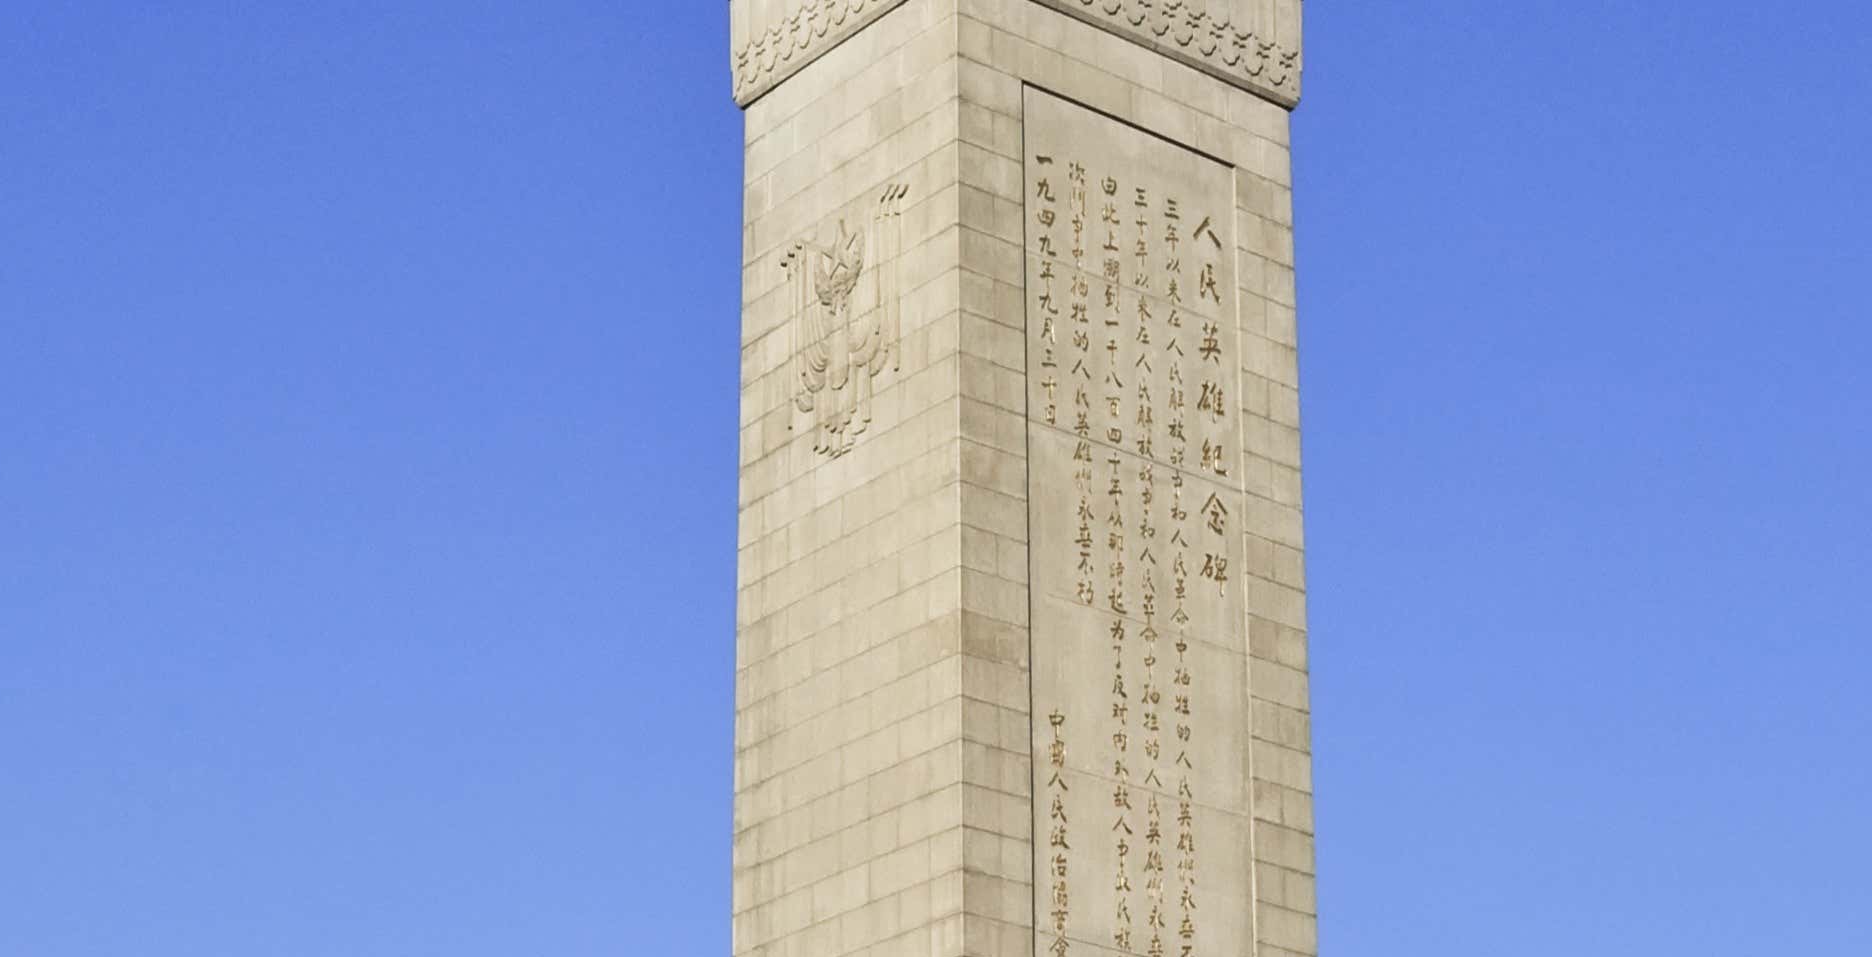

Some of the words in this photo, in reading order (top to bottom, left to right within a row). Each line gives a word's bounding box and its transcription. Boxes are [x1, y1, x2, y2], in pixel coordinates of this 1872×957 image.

[1036, 155, 1059, 426] 一九四九年九月三十日
